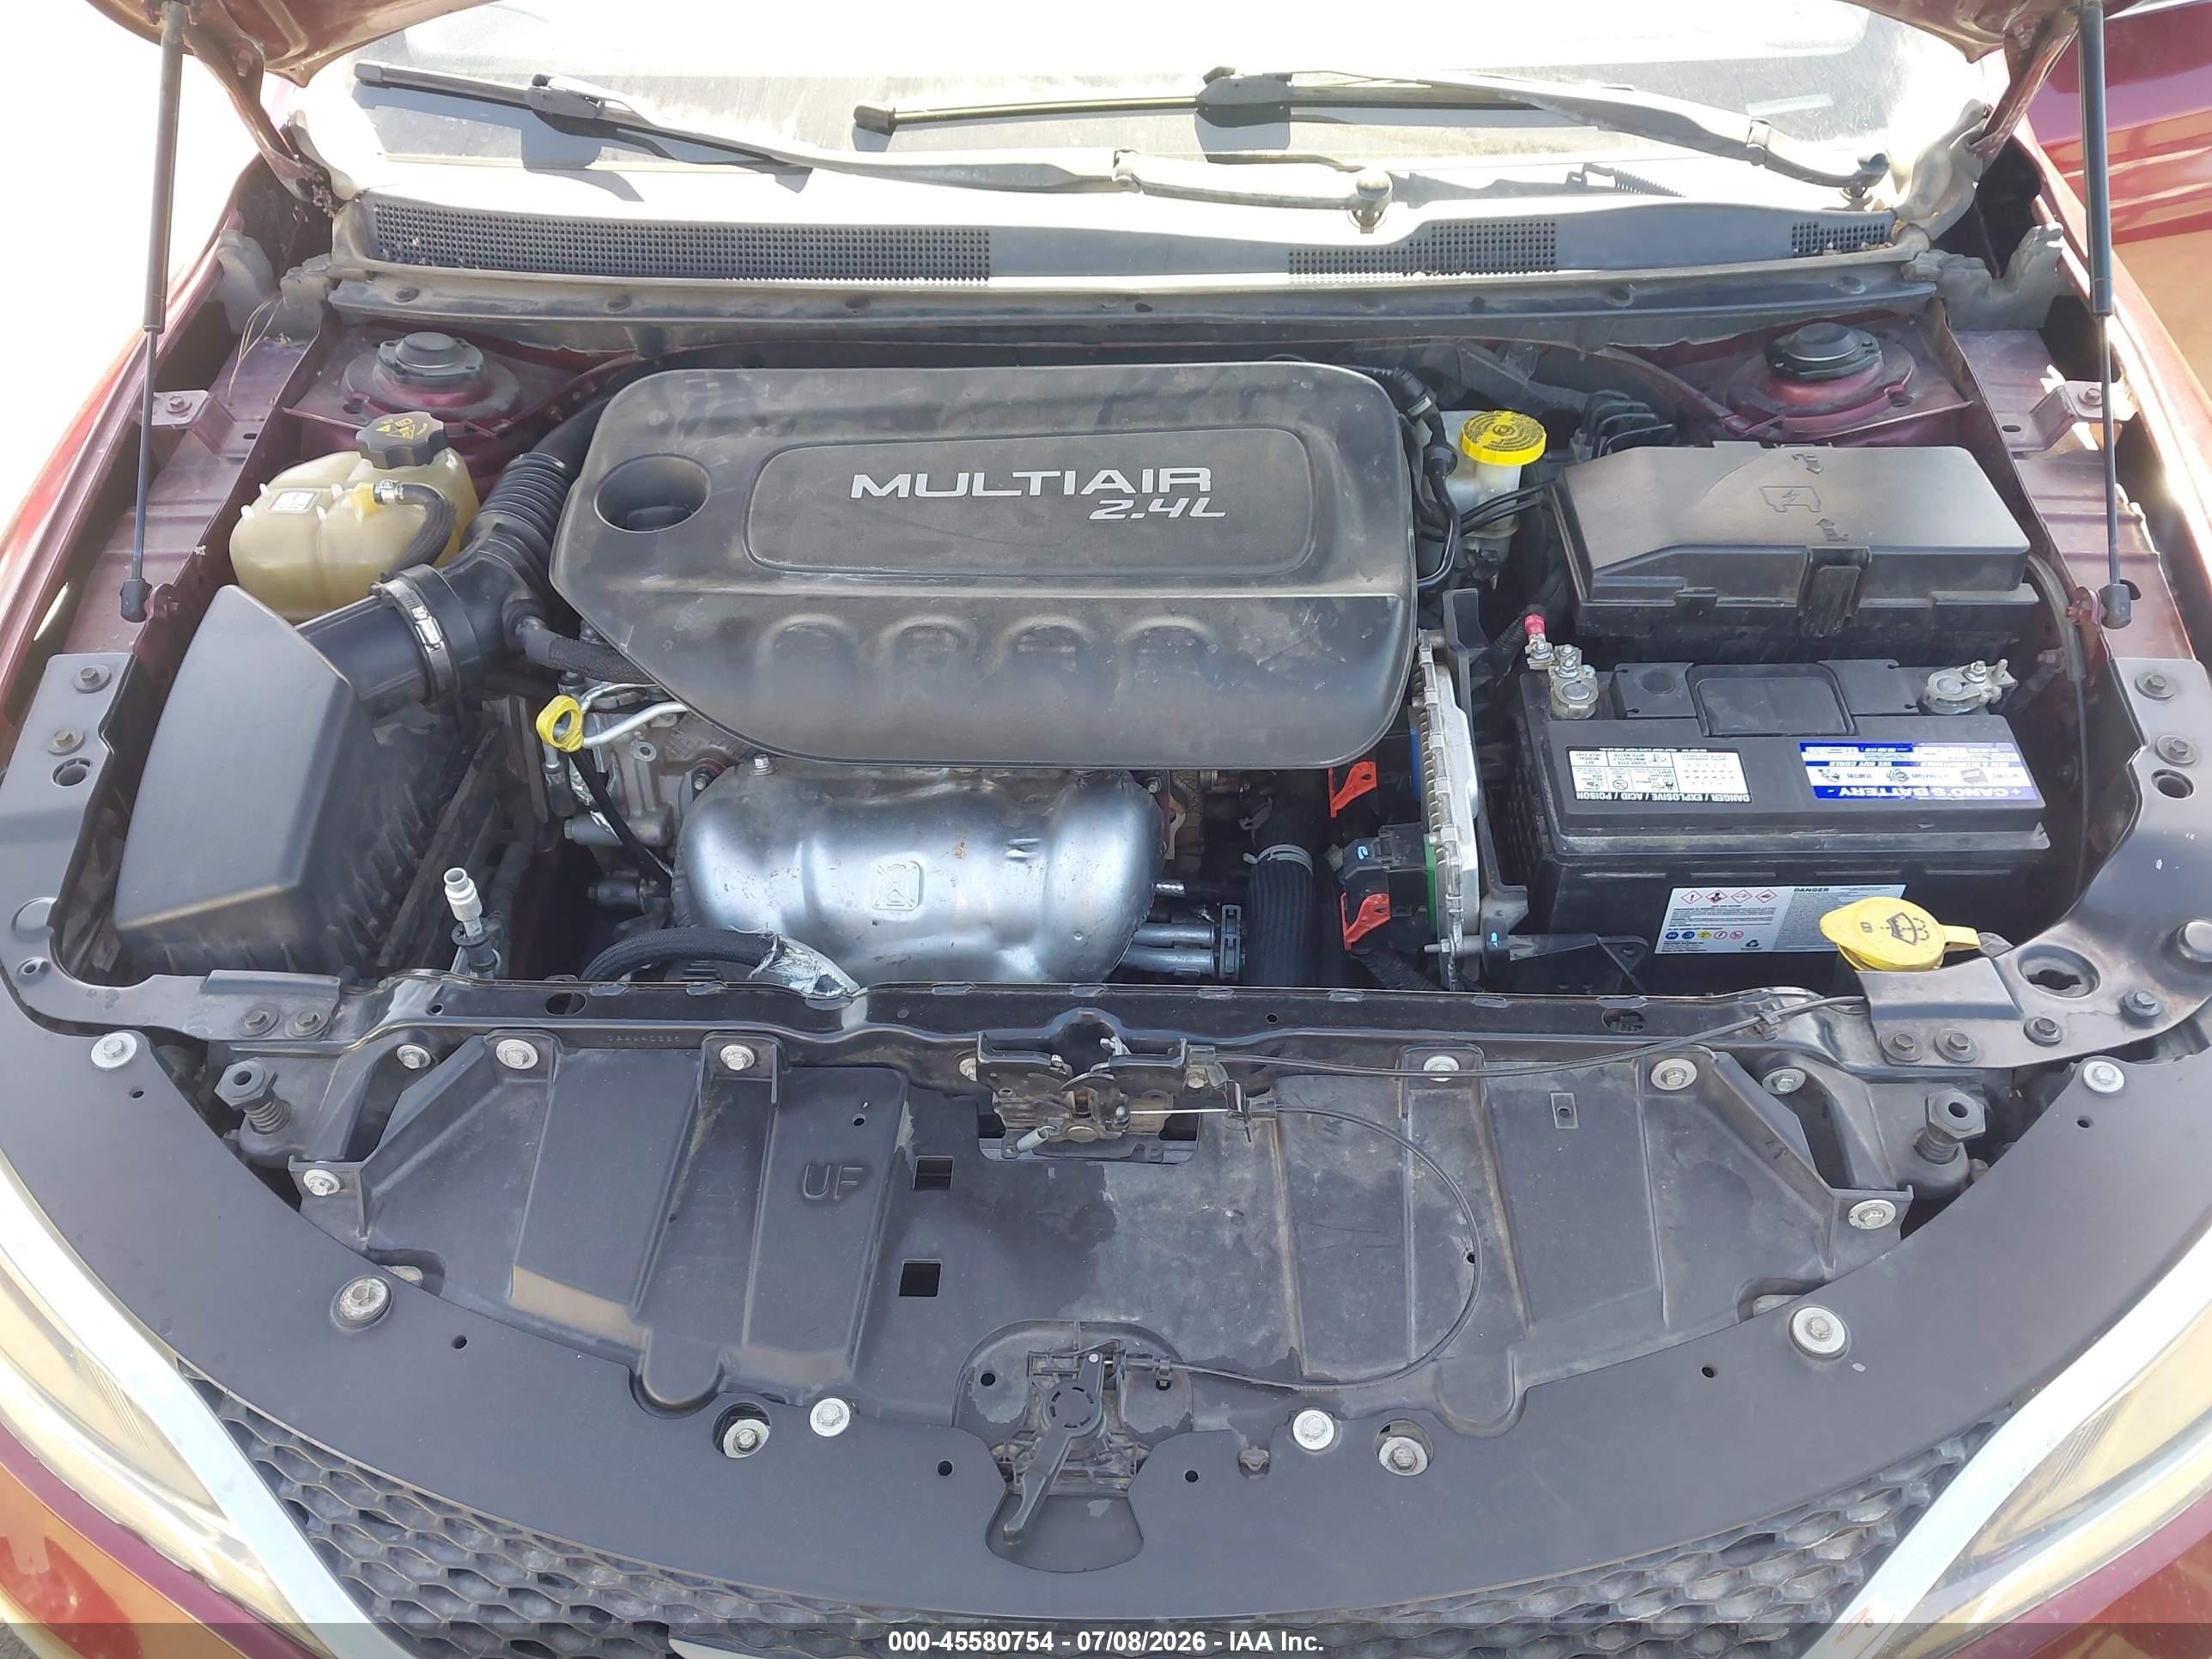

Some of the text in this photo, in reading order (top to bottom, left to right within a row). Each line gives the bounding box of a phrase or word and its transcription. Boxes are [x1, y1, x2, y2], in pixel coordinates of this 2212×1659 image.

[849, 467, 1213, 499] MULTIAIR
[1089, 499, 1226, 520] 2.4L
[1651, 793, 1703, 801] EXPLOSIVE
[1838, 787, 1929, 797] BATTERY
[1931, 787, 2008, 797] CANO'S
[801, 1163, 864, 1201] UF
